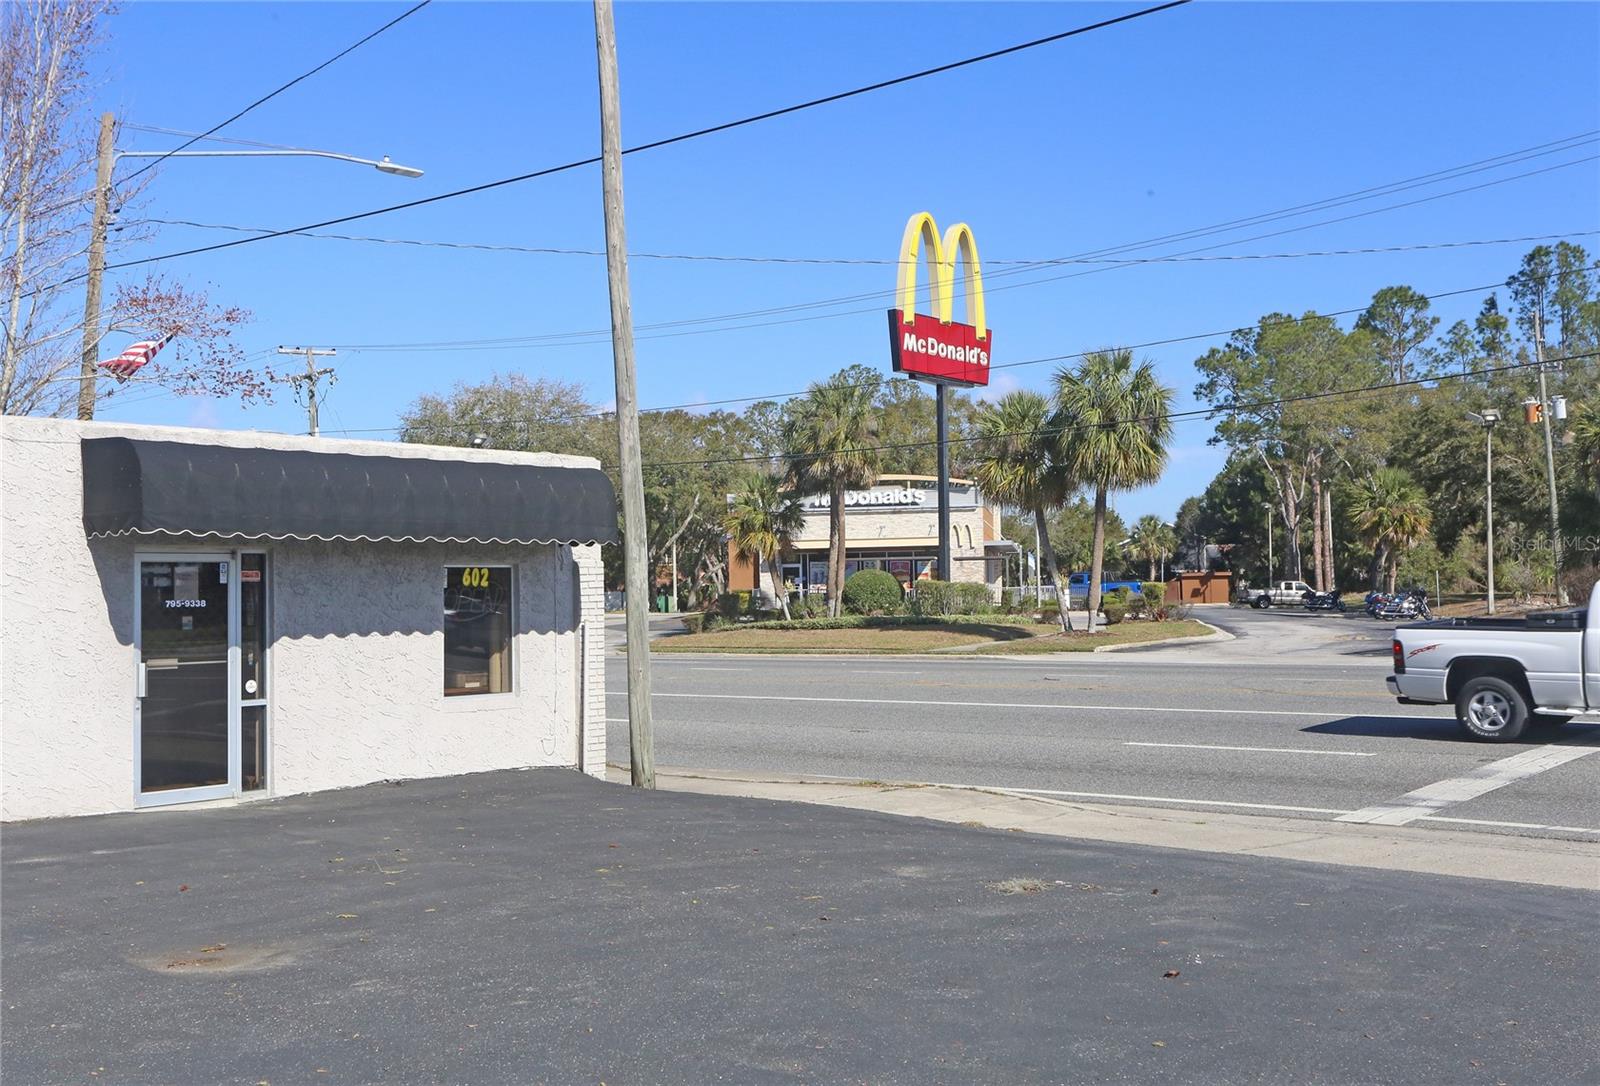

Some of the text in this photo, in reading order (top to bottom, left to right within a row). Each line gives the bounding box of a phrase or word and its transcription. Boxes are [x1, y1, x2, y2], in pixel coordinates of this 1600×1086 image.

[903, 332, 988, 366] McDonald's
[815, 488, 926, 507] MDonald's
[463, 567, 489, 587] 602
[165, 600, 207, 608] 795-9338
